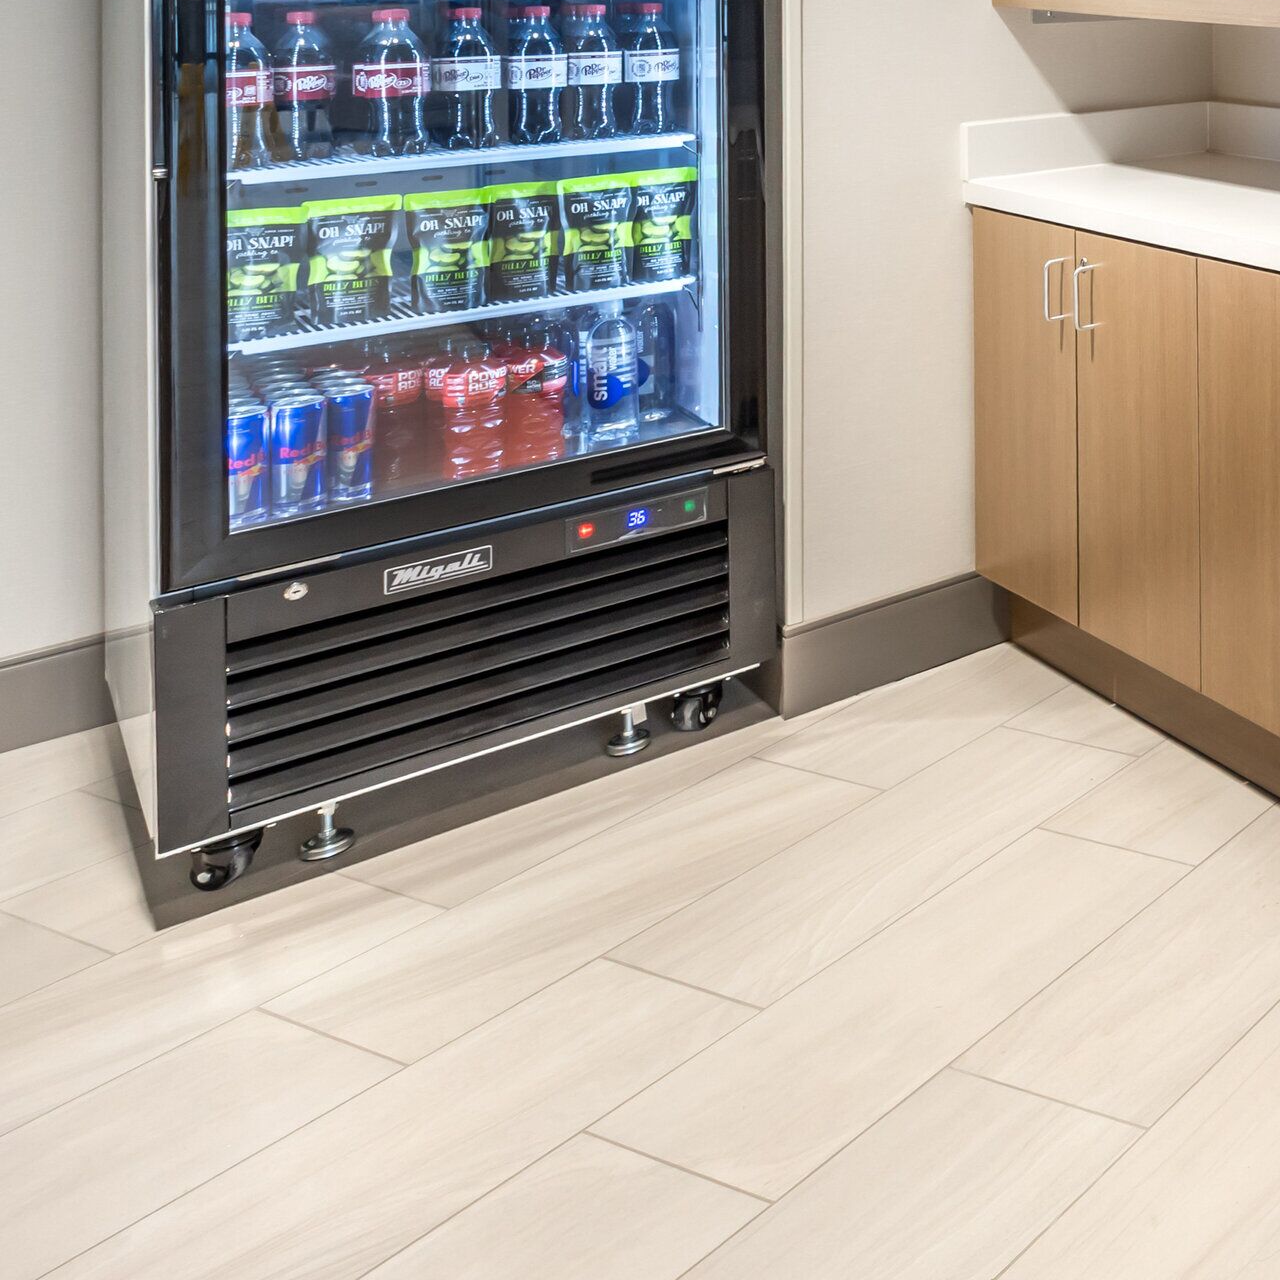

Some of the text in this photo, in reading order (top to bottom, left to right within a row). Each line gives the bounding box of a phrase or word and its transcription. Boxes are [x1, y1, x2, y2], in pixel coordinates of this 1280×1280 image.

[571, 198, 627, 213] OH SNAP!
[420, 215, 483, 231] OH SNAP!
[497, 209, 514, 221] OH
[319, 222, 385, 239] OH SNAP!
[249, 236, 294, 249] SNAP!
[608, 346, 617, 370] water
[280, 446, 310, 459] Red
[628, 510, 646, 526] 36
[391, 553, 487, 586] Migali
